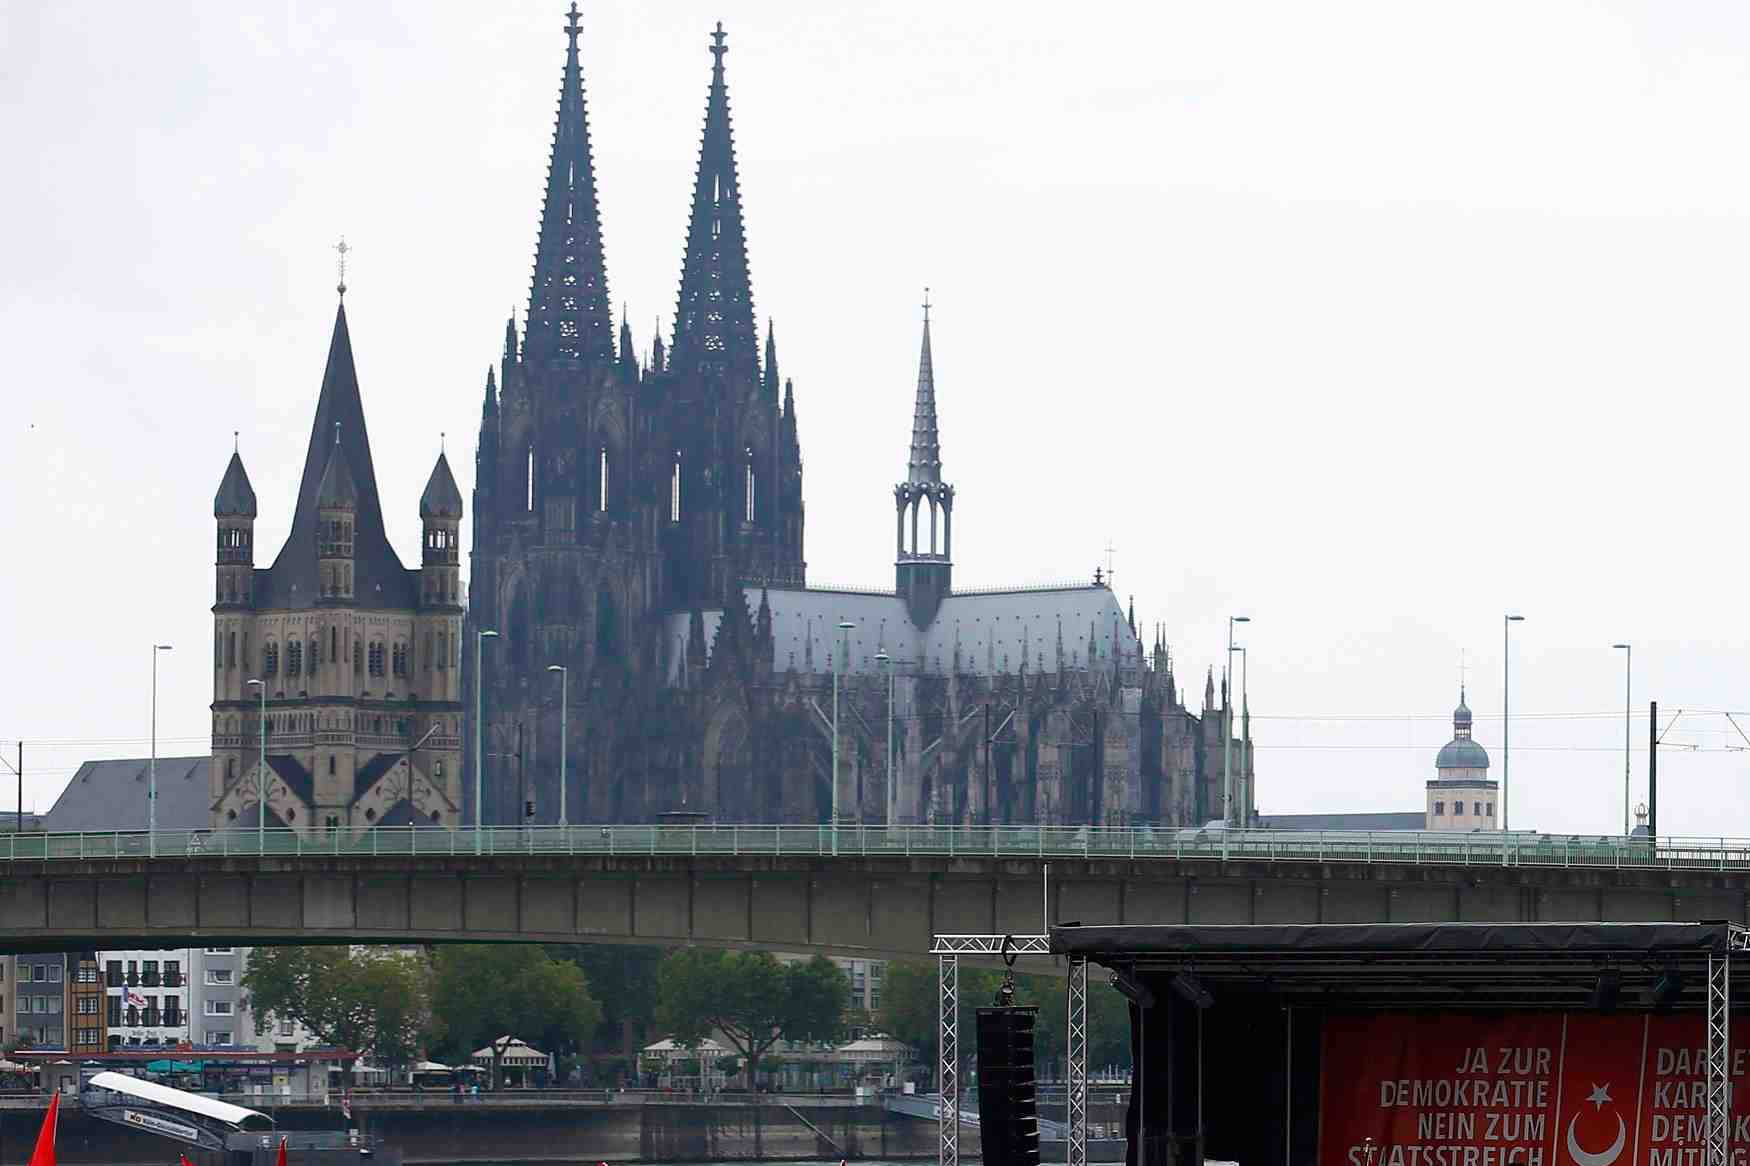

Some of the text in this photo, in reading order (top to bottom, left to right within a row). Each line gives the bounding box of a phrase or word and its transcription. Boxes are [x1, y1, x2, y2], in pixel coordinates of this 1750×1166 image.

[1456, 1047, 1551, 1074] JA ZUR
[1379, 1079, 1550, 1107] DEMOKRATIE
[1654, 1081, 1735, 1109] KARI
[1418, 1112, 1546, 1141] NEIN ZUM
